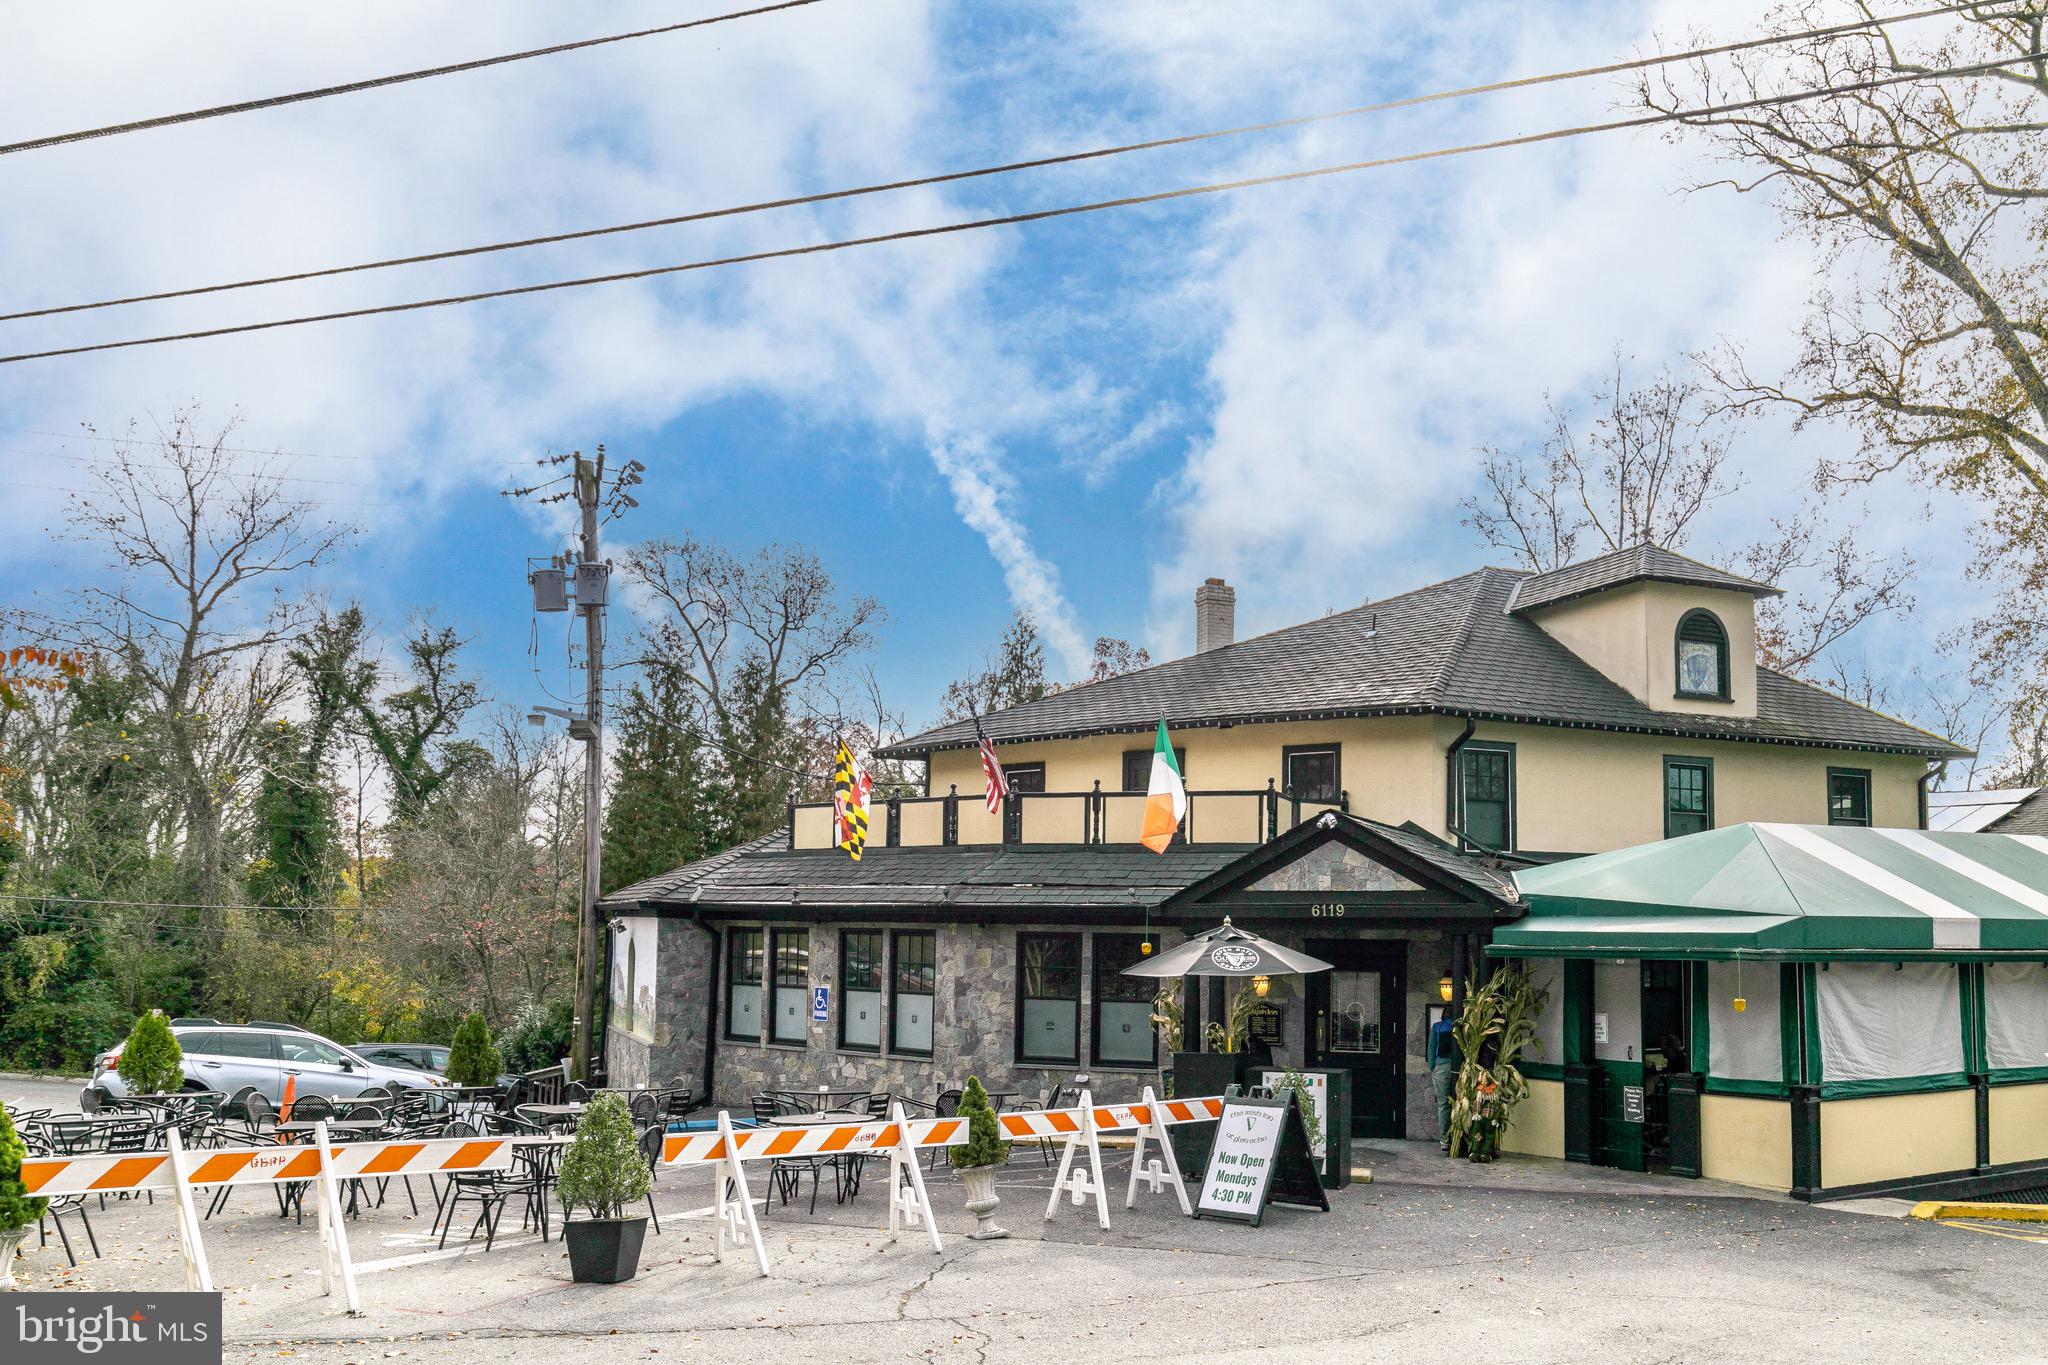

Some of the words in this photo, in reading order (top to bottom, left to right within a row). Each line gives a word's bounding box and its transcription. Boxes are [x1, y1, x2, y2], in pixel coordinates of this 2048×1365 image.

[1312, 904, 1344, 917] 6119
[1218, 1151, 1238, 1165] Now
[1240, 1153, 1265, 1169] Open
[1216, 1169, 1258, 1188] Mondays
[1211, 1188, 1234, 1203] 4:30
[1236, 1190, 1252, 1205] PM
